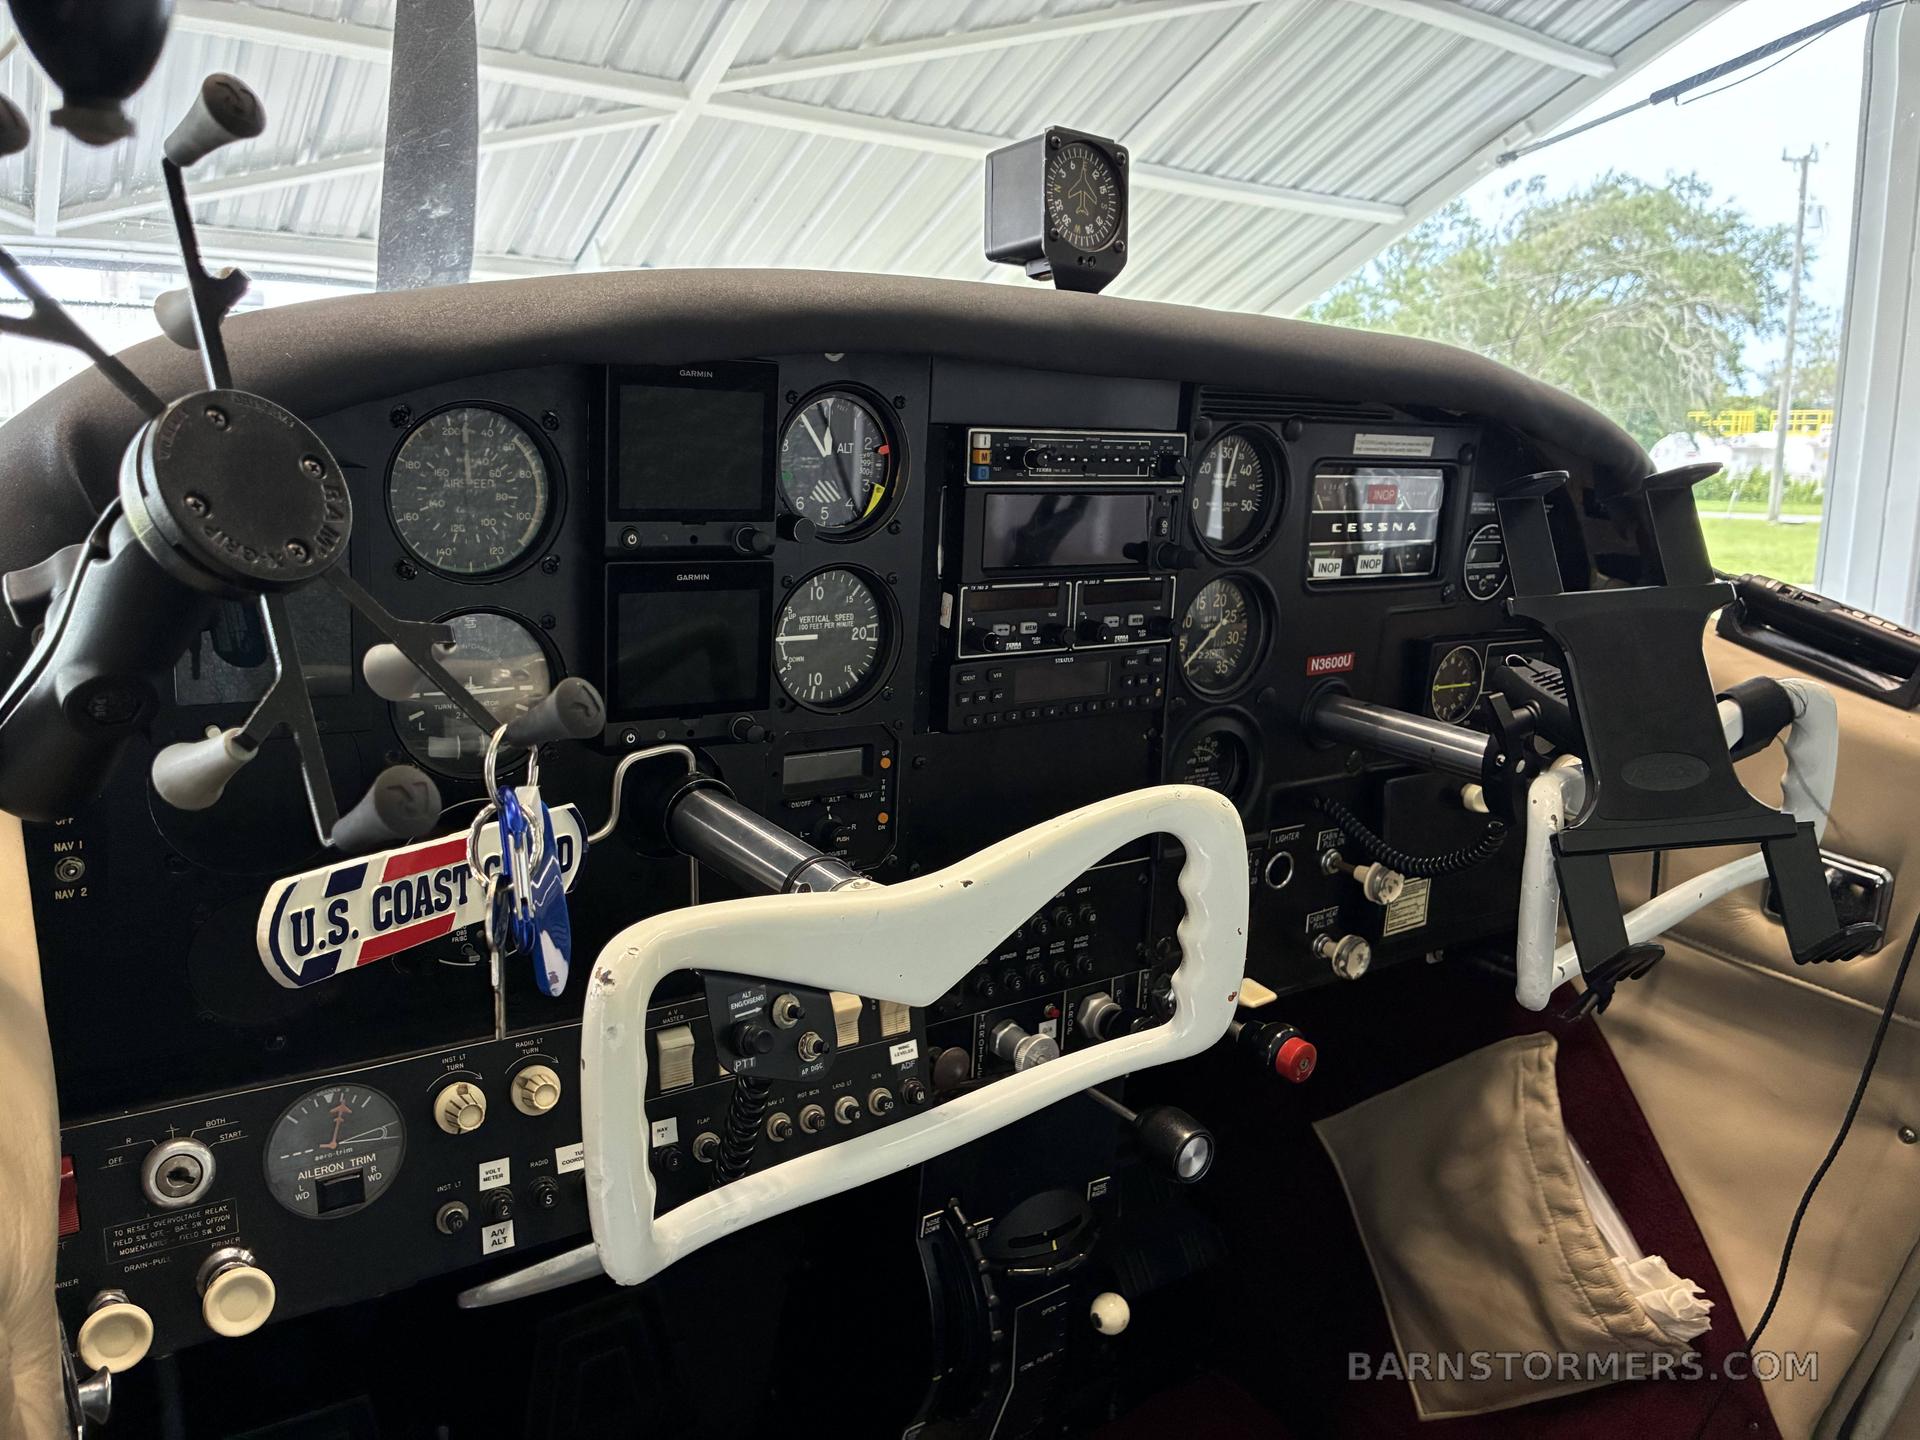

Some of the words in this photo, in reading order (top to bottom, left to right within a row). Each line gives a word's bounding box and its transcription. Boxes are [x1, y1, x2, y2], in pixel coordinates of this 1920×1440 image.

[1059, 168, 1066, 178] 3
[679, 370, 713, 378] GARMIN
[481, 430, 494, 438] 40
[836, 443, 854, 453] ALT
[864, 437, 873, 449] 2
[405, 461, 421, 470] 180
[1200, 462, 1211, 474] 20
[1240, 464, 1252, 476] 40
[863, 479, 870, 492] 3
[1373, 489, 1395, 500] INOP
[796, 497, 804, 510] 6
[845, 498, 854, 511] 4
[1192, 498, 1199, 510] 0
[1241, 500, 1252, 511] 50
[403, 513, 419, 521] 160
[516, 512, 531, 521] 100
[821, 507, 829, 520] 5
[1332, 522, 1417, 533] CESSNA
[436, 548, 451, 556] 140
[489, 547, 504, 555] 120
[1318, 562, 1340, 573] INOP
[1360, 559, 1381, 569] INOP
[811, 587, 824, 601] 10
[1196, 596, 1206, 610] 15
[1213, 594, 1227, 608] 20
[799, 615, 830, 624] VERTICAL
[835, 613, 855, 622] SPEED
[1182, 614, 1192, 628] 10
[1224, 610, 1237, 622] 25
[851, 627, 867, 641] 20
[1226, 631, 1239, 644] 30
[1215, 660, 1228, 674] 35
[1311, 654, 1351, 672] N3600U
[808, 672, 823, 686] 10
[418, 722, 425, 731] L
[1275, 832, 1300, 843] LIGHTER
[54, 841, 74, 852] NAV
[55, 889, 75, 900] NAV
[80, 887, 88, 896] 2
[290, 898, 359, 957] U.S.
[372, 864, 471, 931] COAST
[741, 990, 752, 999] ALT
[730, 994, 765, 1010] ENG/DISENG
[662, 1014, 685, 1024] MASTER
[515, 1039, 534, 1048] RADIO
[977, 1014, 986, 1079] THROTTLE
[522, 1046, 539, 1056] TURN
[442, 1055, 457, 1064] INST
[735, 1056, 755, 1070] PTT
[446, 1062, 464, 1072] TURN
[810, 1062, 824, 1072] DISC
[900, 1061, 916, 1071] ADF
[884, 1101, 894, 1110] 50
[205, 1117, 226, 1127] BOTH
[219, 1130, 242, 1141] START
[108, 1156, 123, 1165] OFF
[530, 1158, 549, 1168] RADIO
[297, 1162, 345, 1180] AILERON
[350, 1153, 376, 1167] TRIM
[485, 1167, 501, 1176] VOLT
[368, 1172, 383, 1182] WD
[483, 1172, 504, 1183] METER
[437, 1183, 452, 1192] INST
[295, 1191, 310, 1201] WD
[546, 1194, 553, 1205] 5
[502, 1205, 509, 1216] 2
[127, 1224, 150, 1234] RESET
[153, 1212, 201, 1228] OVERVOLTAGE
[113, 1238, 133, 1248] FIELD
[206, 1214, 231, 1225] OFF/ON
[490, 1228, 506, 1238] A/V
[211, 1237, 240, 1249] PRIMER
[490, 1236, 508, 1247] ALT
